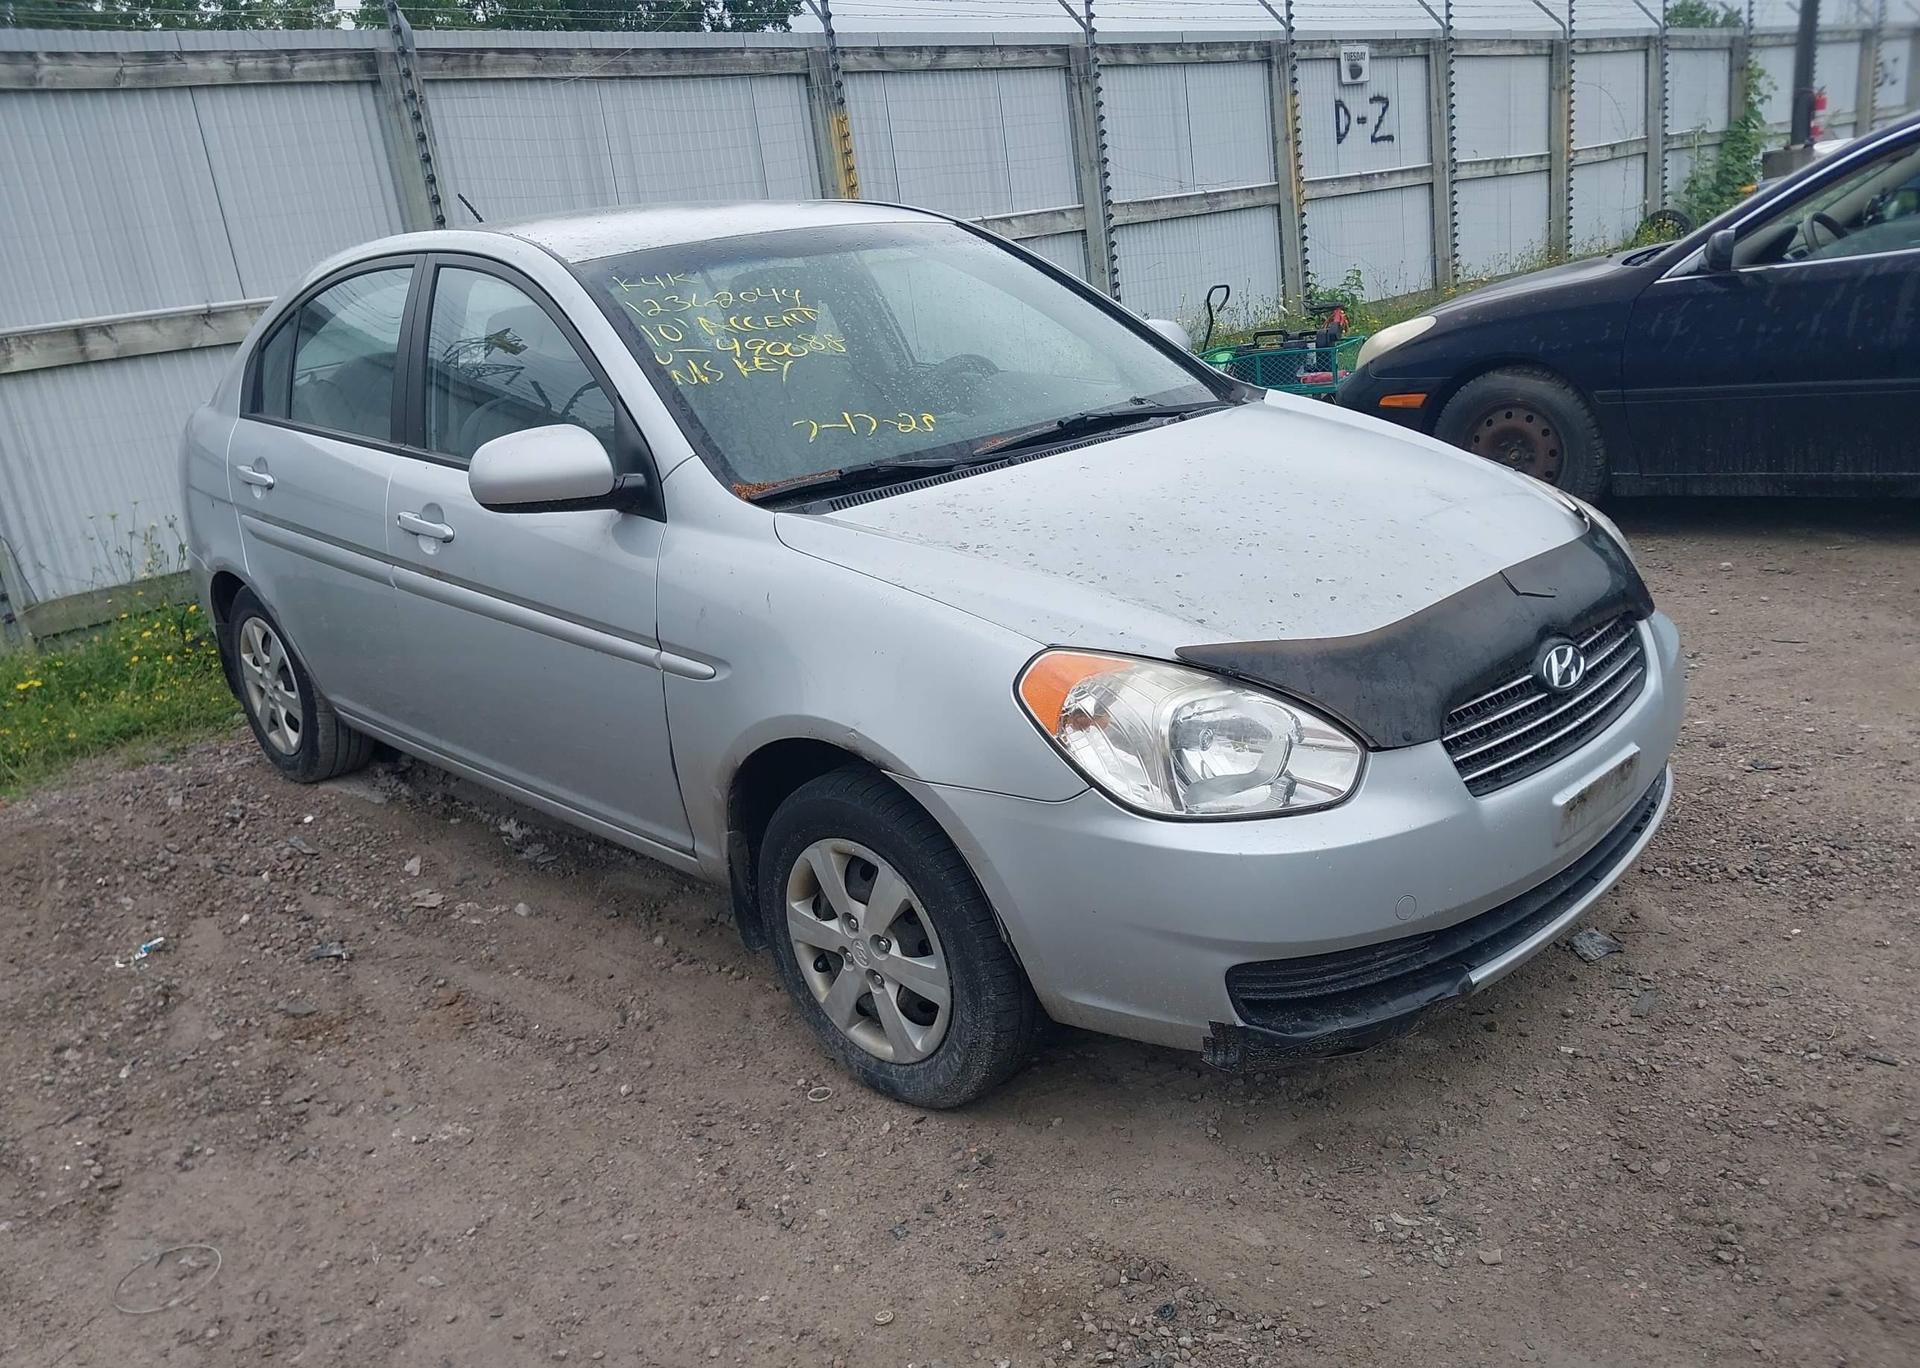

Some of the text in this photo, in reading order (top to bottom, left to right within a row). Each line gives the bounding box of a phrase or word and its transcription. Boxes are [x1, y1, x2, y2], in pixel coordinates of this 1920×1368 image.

[1343, 51, 1367, 62] TUESDAY
[697, 306, 820, 336] ACCENT
[732, 356, 795, 385] KEY
